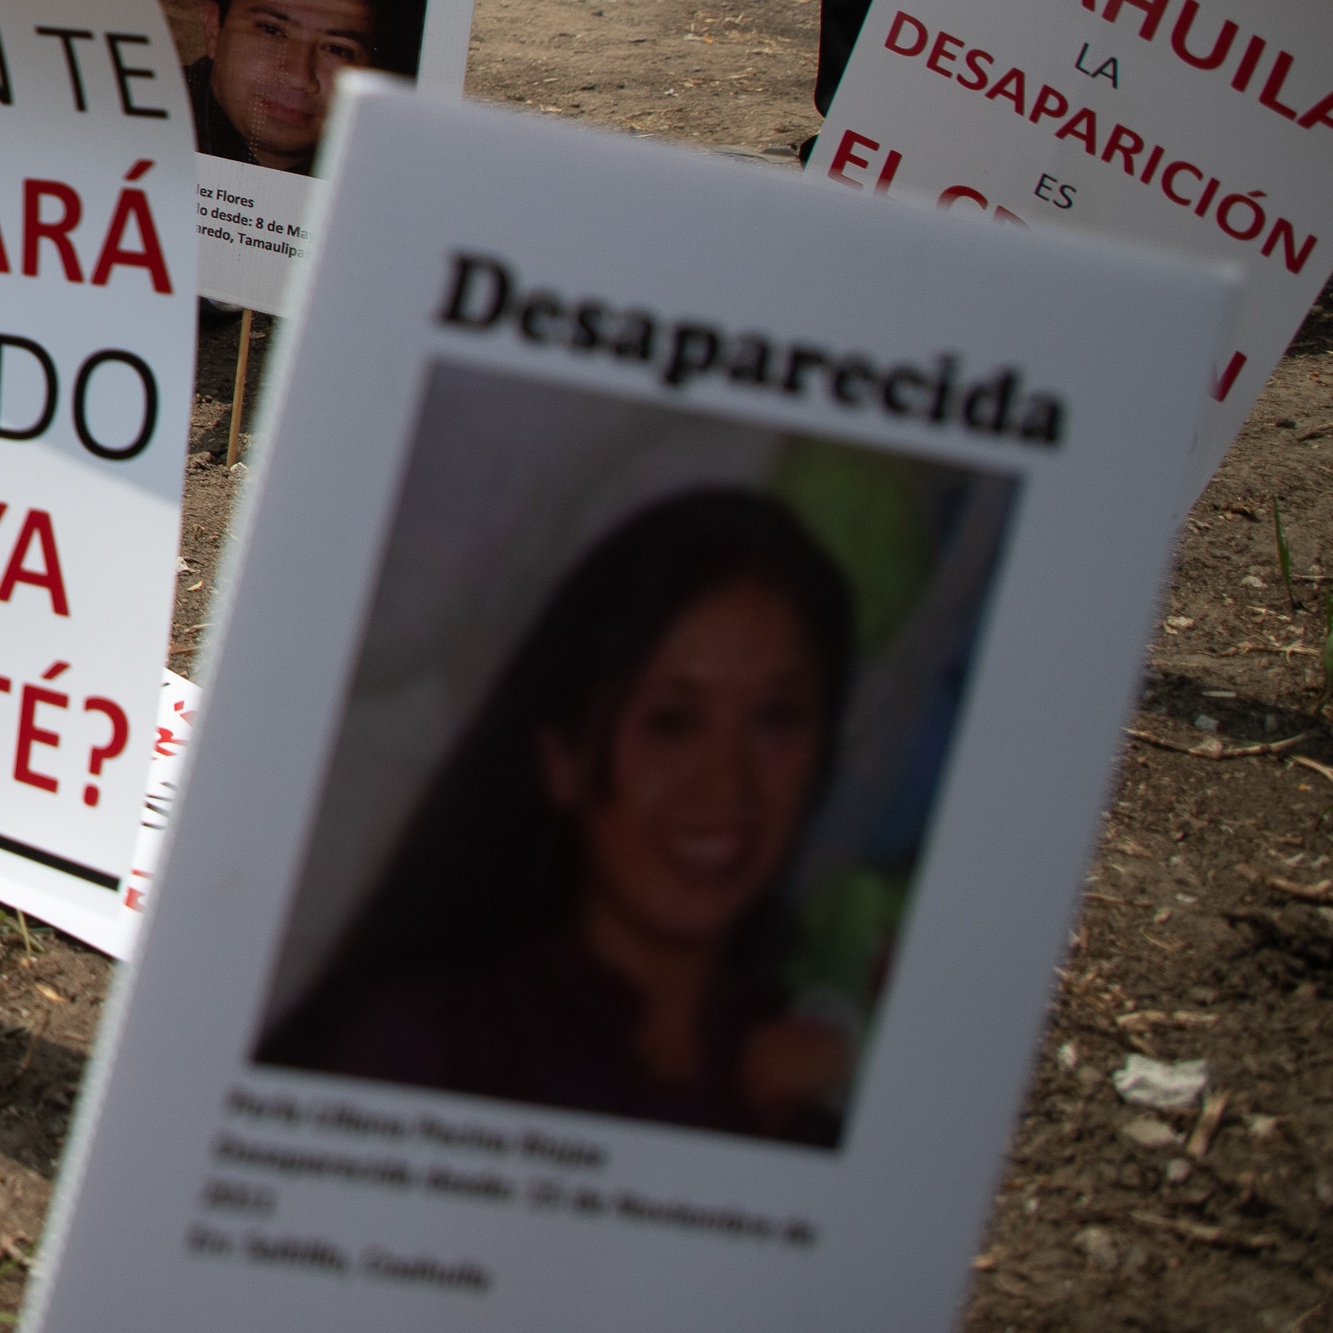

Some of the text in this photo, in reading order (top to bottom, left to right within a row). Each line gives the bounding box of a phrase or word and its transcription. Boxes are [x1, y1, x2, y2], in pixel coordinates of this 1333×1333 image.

[34, 25, 170, 120] TE
[1073, 42, 1120, 90] LA
[884, 10, 1317, 275] DESAPARICIÓN
[216, 189, 254, 208] Flores
[1033, 173, 1078, 210] ES
[211, 208, 253, 226] desde:
[255, 218, 264, 229] 8
[267, 221, 284, 234] de
[438, 249, 1068, 449] Desaparecida
